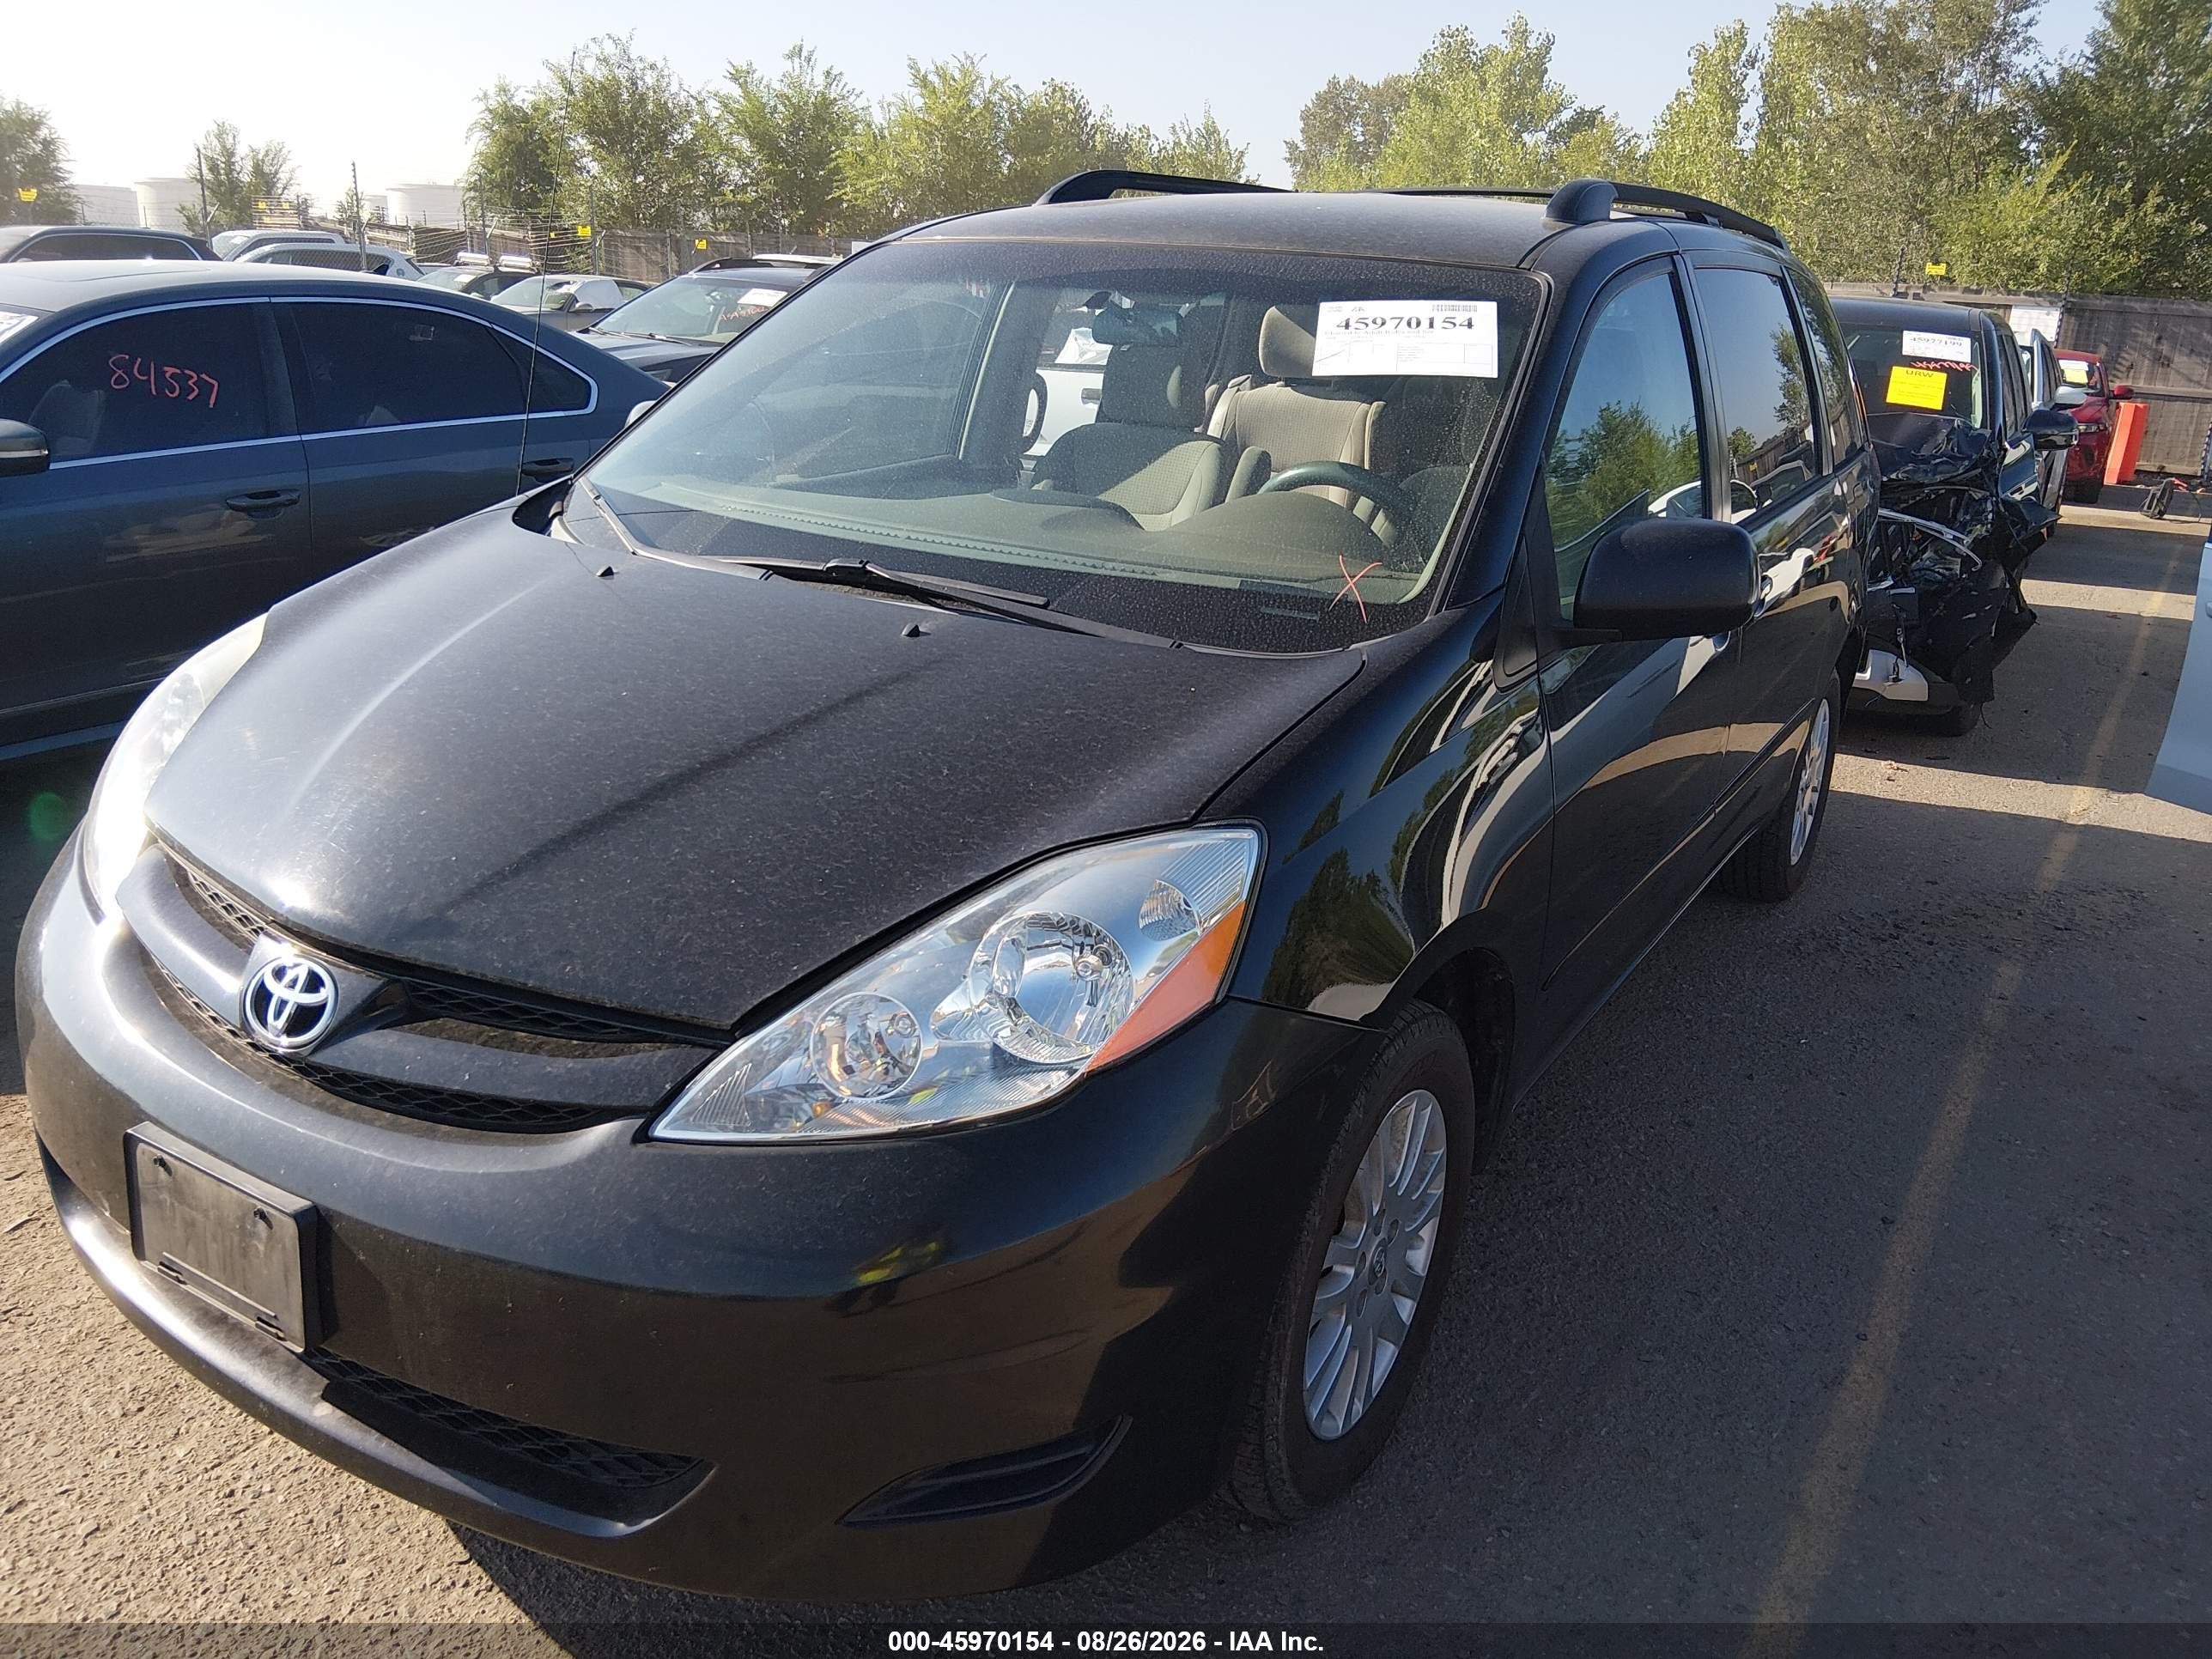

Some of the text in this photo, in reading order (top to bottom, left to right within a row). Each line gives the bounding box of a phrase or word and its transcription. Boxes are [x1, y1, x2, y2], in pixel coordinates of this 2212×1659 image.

[1336, 316, 1474, 331] 45970154
[108, 354, 219, 409] 84537
[1905, 369, 1934, 379] URW
